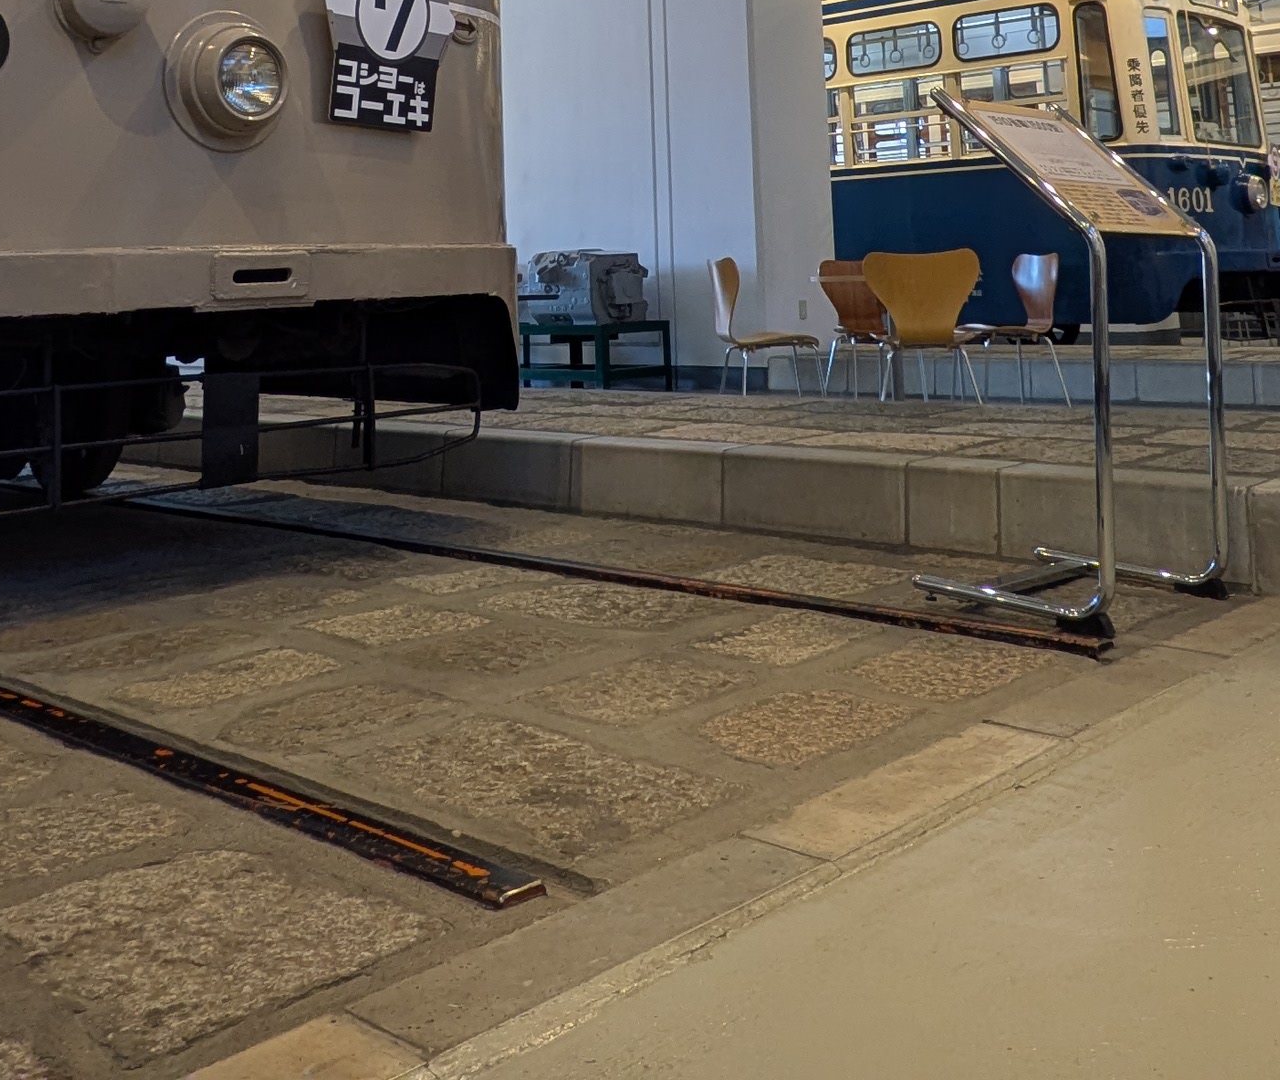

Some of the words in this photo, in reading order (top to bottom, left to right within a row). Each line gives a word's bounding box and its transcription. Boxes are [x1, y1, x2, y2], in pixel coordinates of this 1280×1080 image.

[337, 58, 426, 95] コショーは
[334, 85, 429, 127] コーエキ
[1167, 186, 1215, 213] 1601
